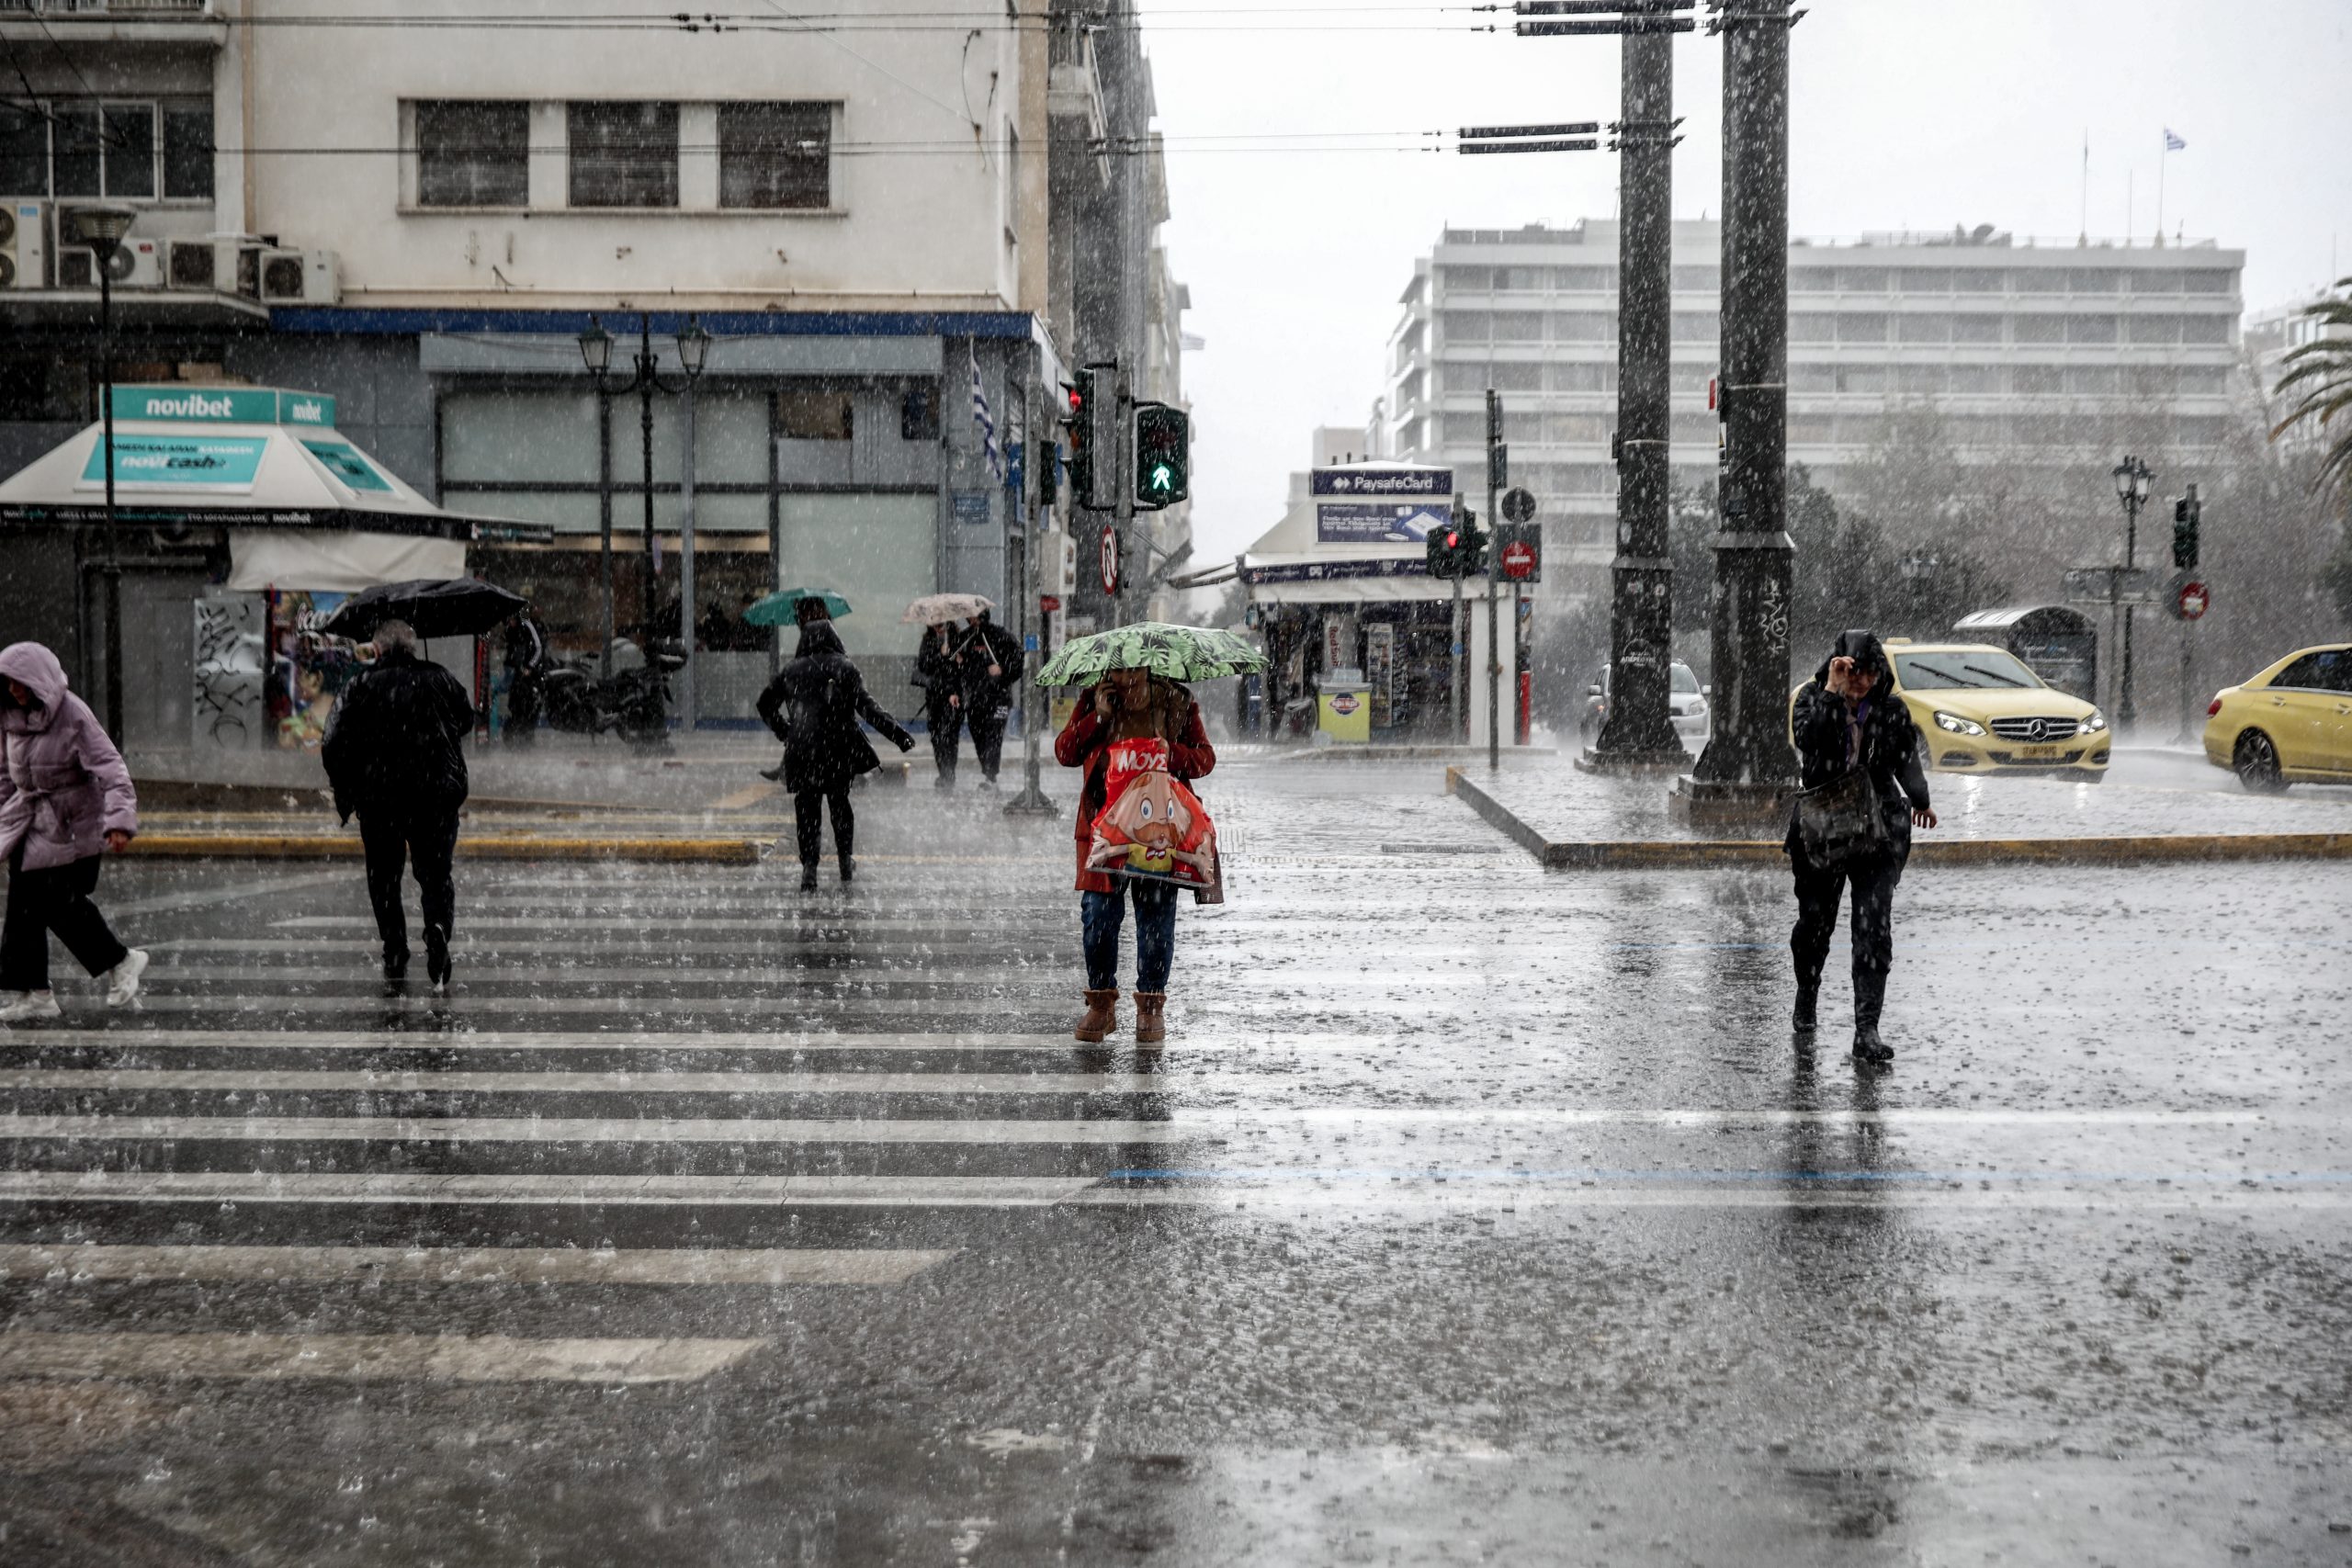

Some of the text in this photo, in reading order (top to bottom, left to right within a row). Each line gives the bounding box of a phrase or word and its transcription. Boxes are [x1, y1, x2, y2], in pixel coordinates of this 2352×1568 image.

[146, 393, 232, 418] novibet
[292, 399, 322, 423] novibet
[1354, 476, 1433, 491] PaysafeCard
[273, 512, 311, 524] novibet
